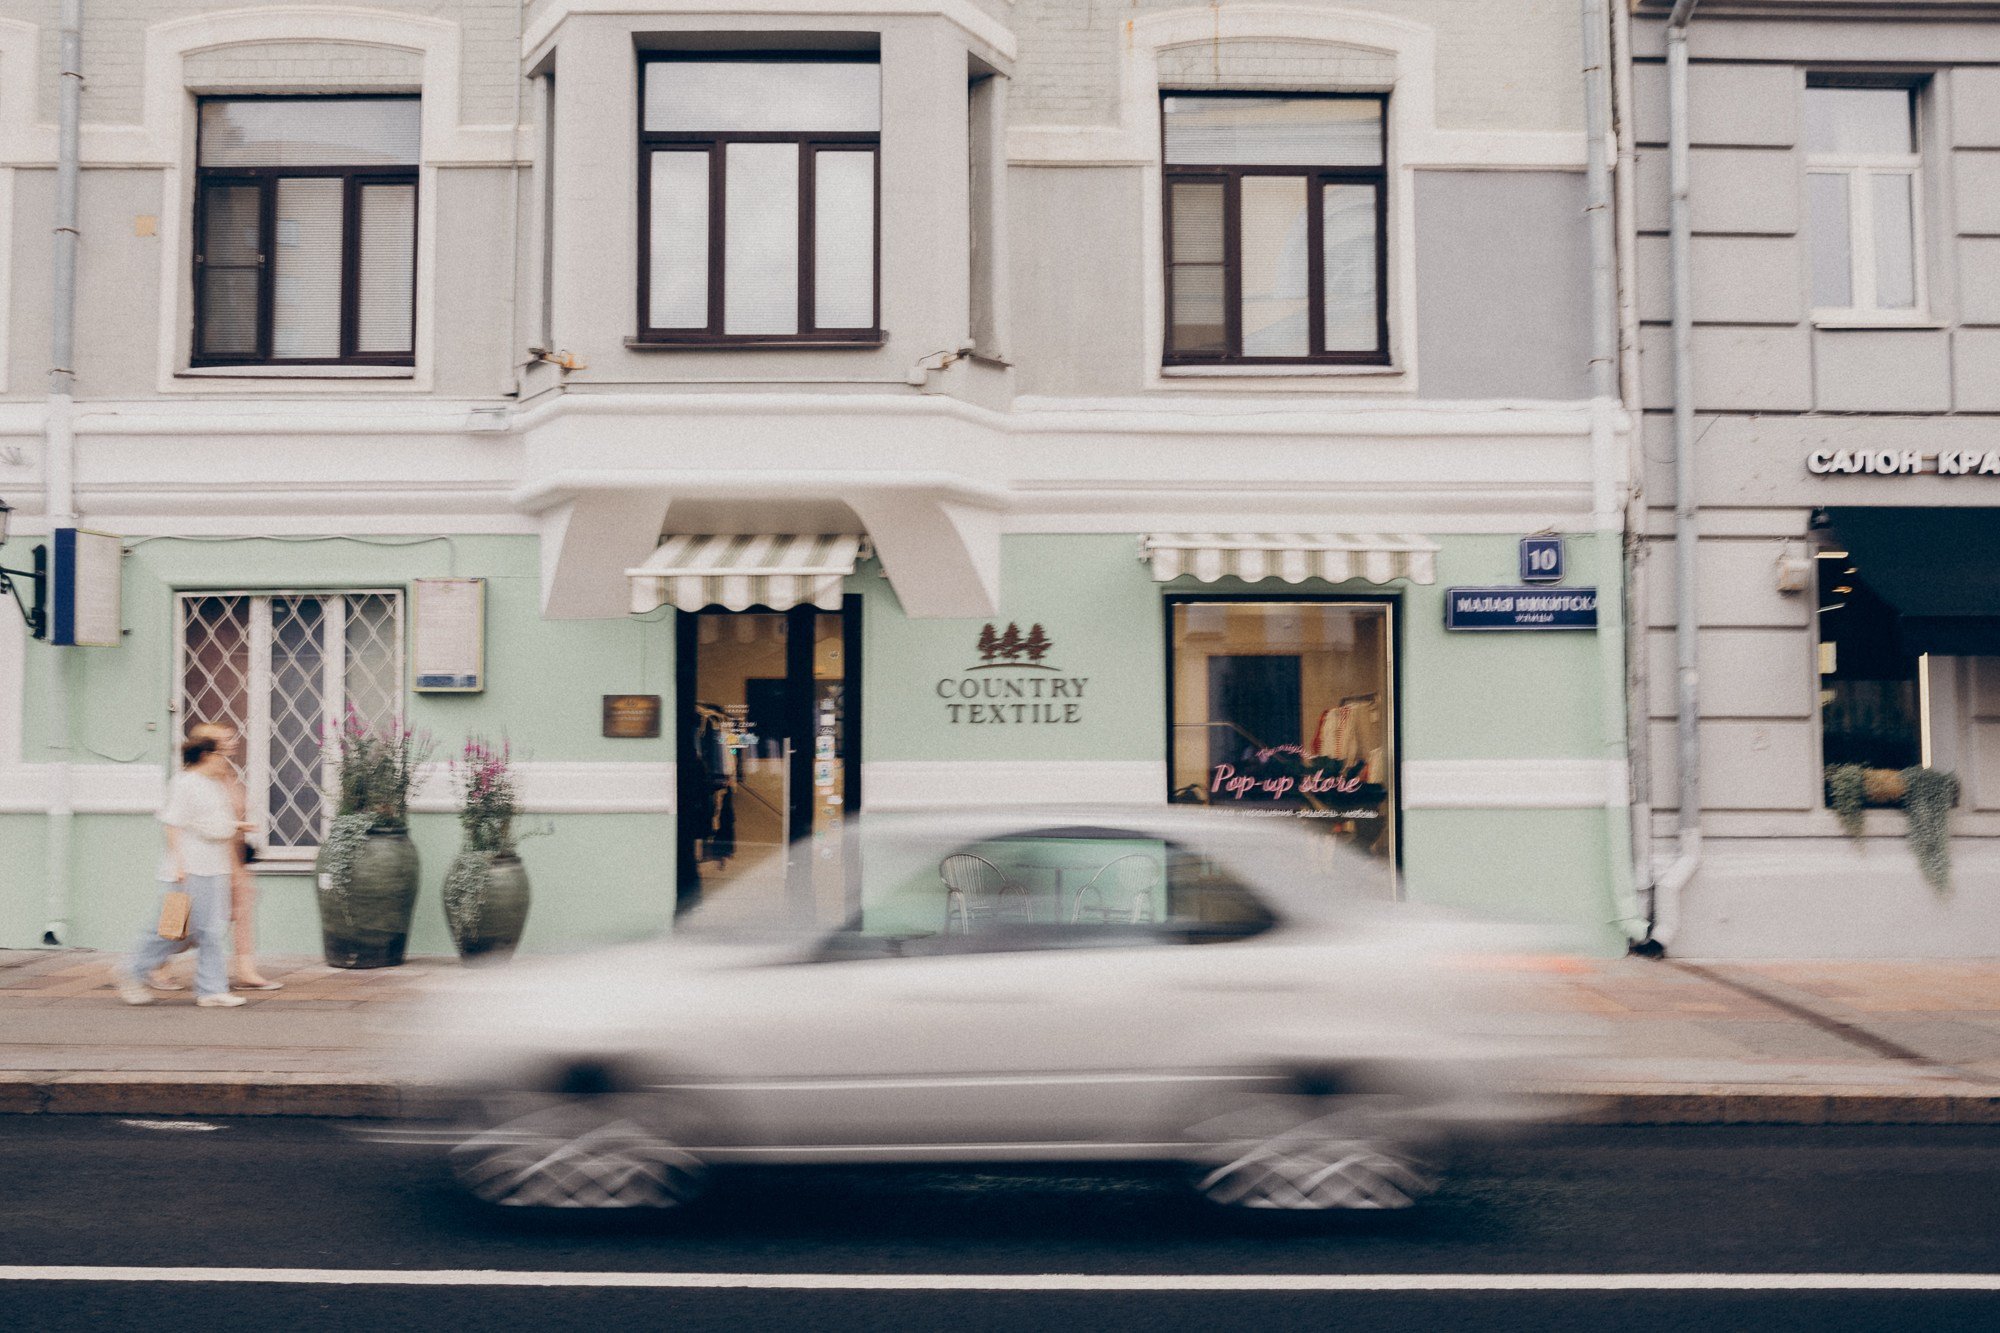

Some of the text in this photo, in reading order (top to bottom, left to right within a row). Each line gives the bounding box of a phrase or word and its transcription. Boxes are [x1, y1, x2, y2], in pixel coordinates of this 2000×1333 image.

[1807, 449, 2000, 475] САЛОН КРА
[1529, 549, 1557, 570] 10
[1457, 596, 1514, 612] МАЛАЯ
[936, 677, 1089, 699] COUNTRY
[946, 703, 1082, 724] TEXTILE
[1211, 763, 1363, 800] Pop-up store
